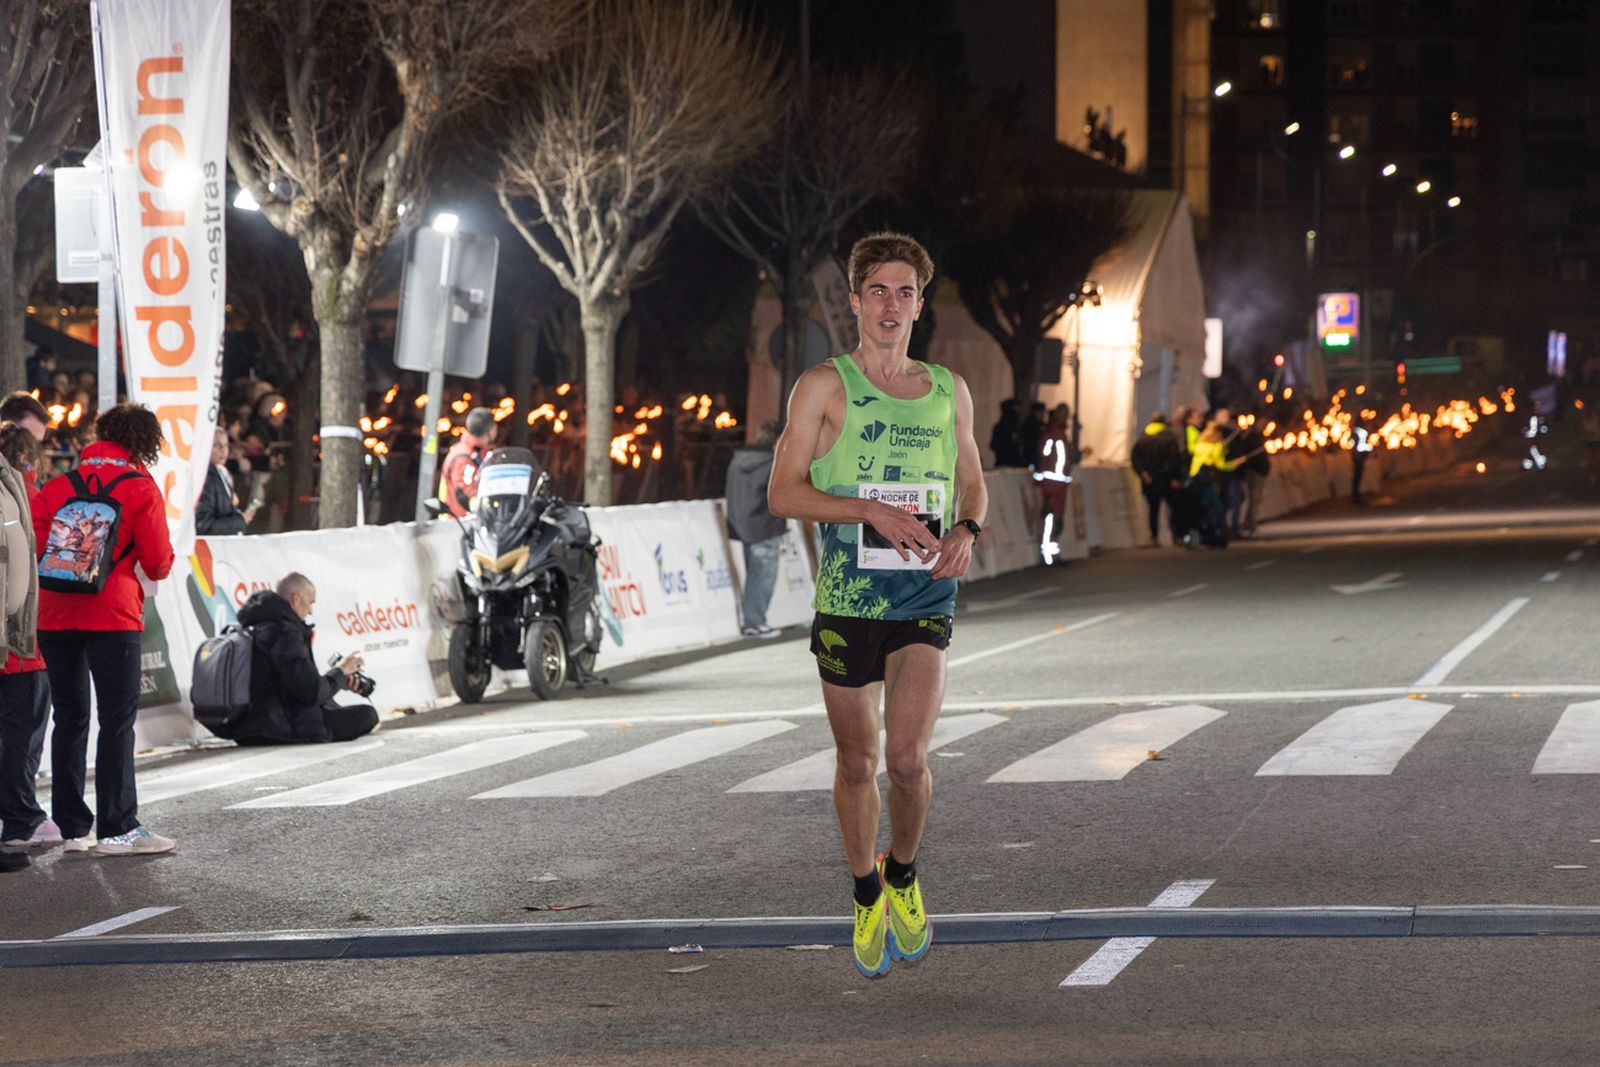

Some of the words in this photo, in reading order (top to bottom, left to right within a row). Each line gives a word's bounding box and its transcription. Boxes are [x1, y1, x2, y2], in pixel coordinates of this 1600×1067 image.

[889, 436, 931, 451] Unicaja
[881, 493, 907, 502] NOCHE
[908, 494, 919, 502] DE
[336, 598, 420, 636] calderón
